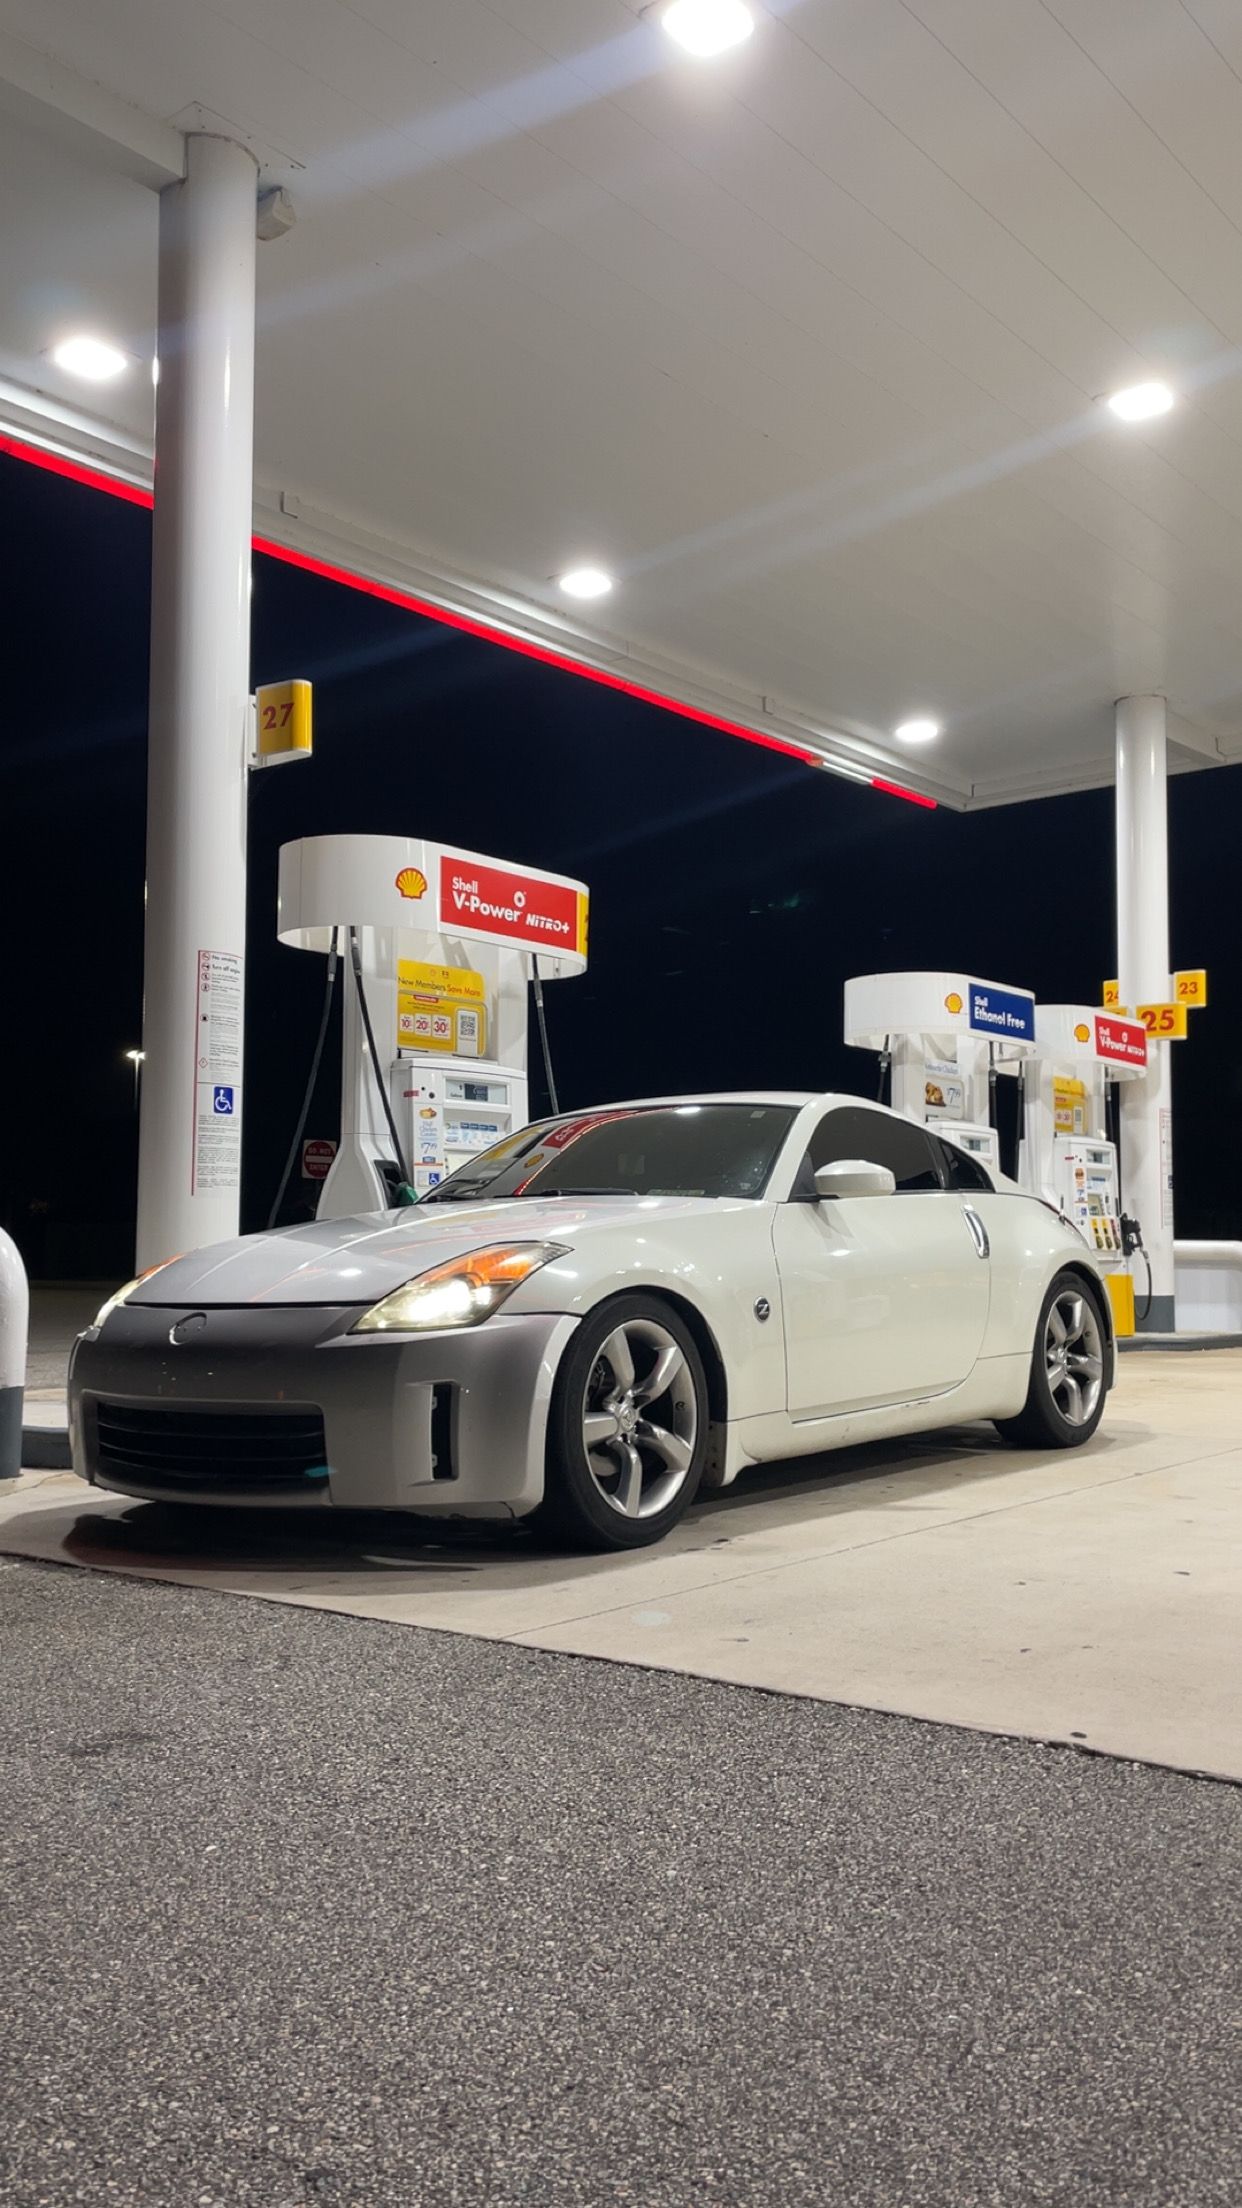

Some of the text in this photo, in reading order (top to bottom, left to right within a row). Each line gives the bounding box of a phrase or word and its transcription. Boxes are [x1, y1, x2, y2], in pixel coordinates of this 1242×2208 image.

[263, 702, 295, 730] 27
[452, 876, 478, 893] Shell
[452, 890, 522, 922] V-Power
[397, 976, 414, 985] New
[415, 979, 446, 991] Members
[1179, 981, 1198, 995] 23
[974, 995, 988, 1007] Shell
[974, 1005, 1025, 1029] Ethanol Free
[1141, 1008, 1175, 1031] 25
[1098, 1035, 1127, 1052] V-Power
[308, 1146, 317, 1154] DO
[758, 1303, 769, 1315] Z
